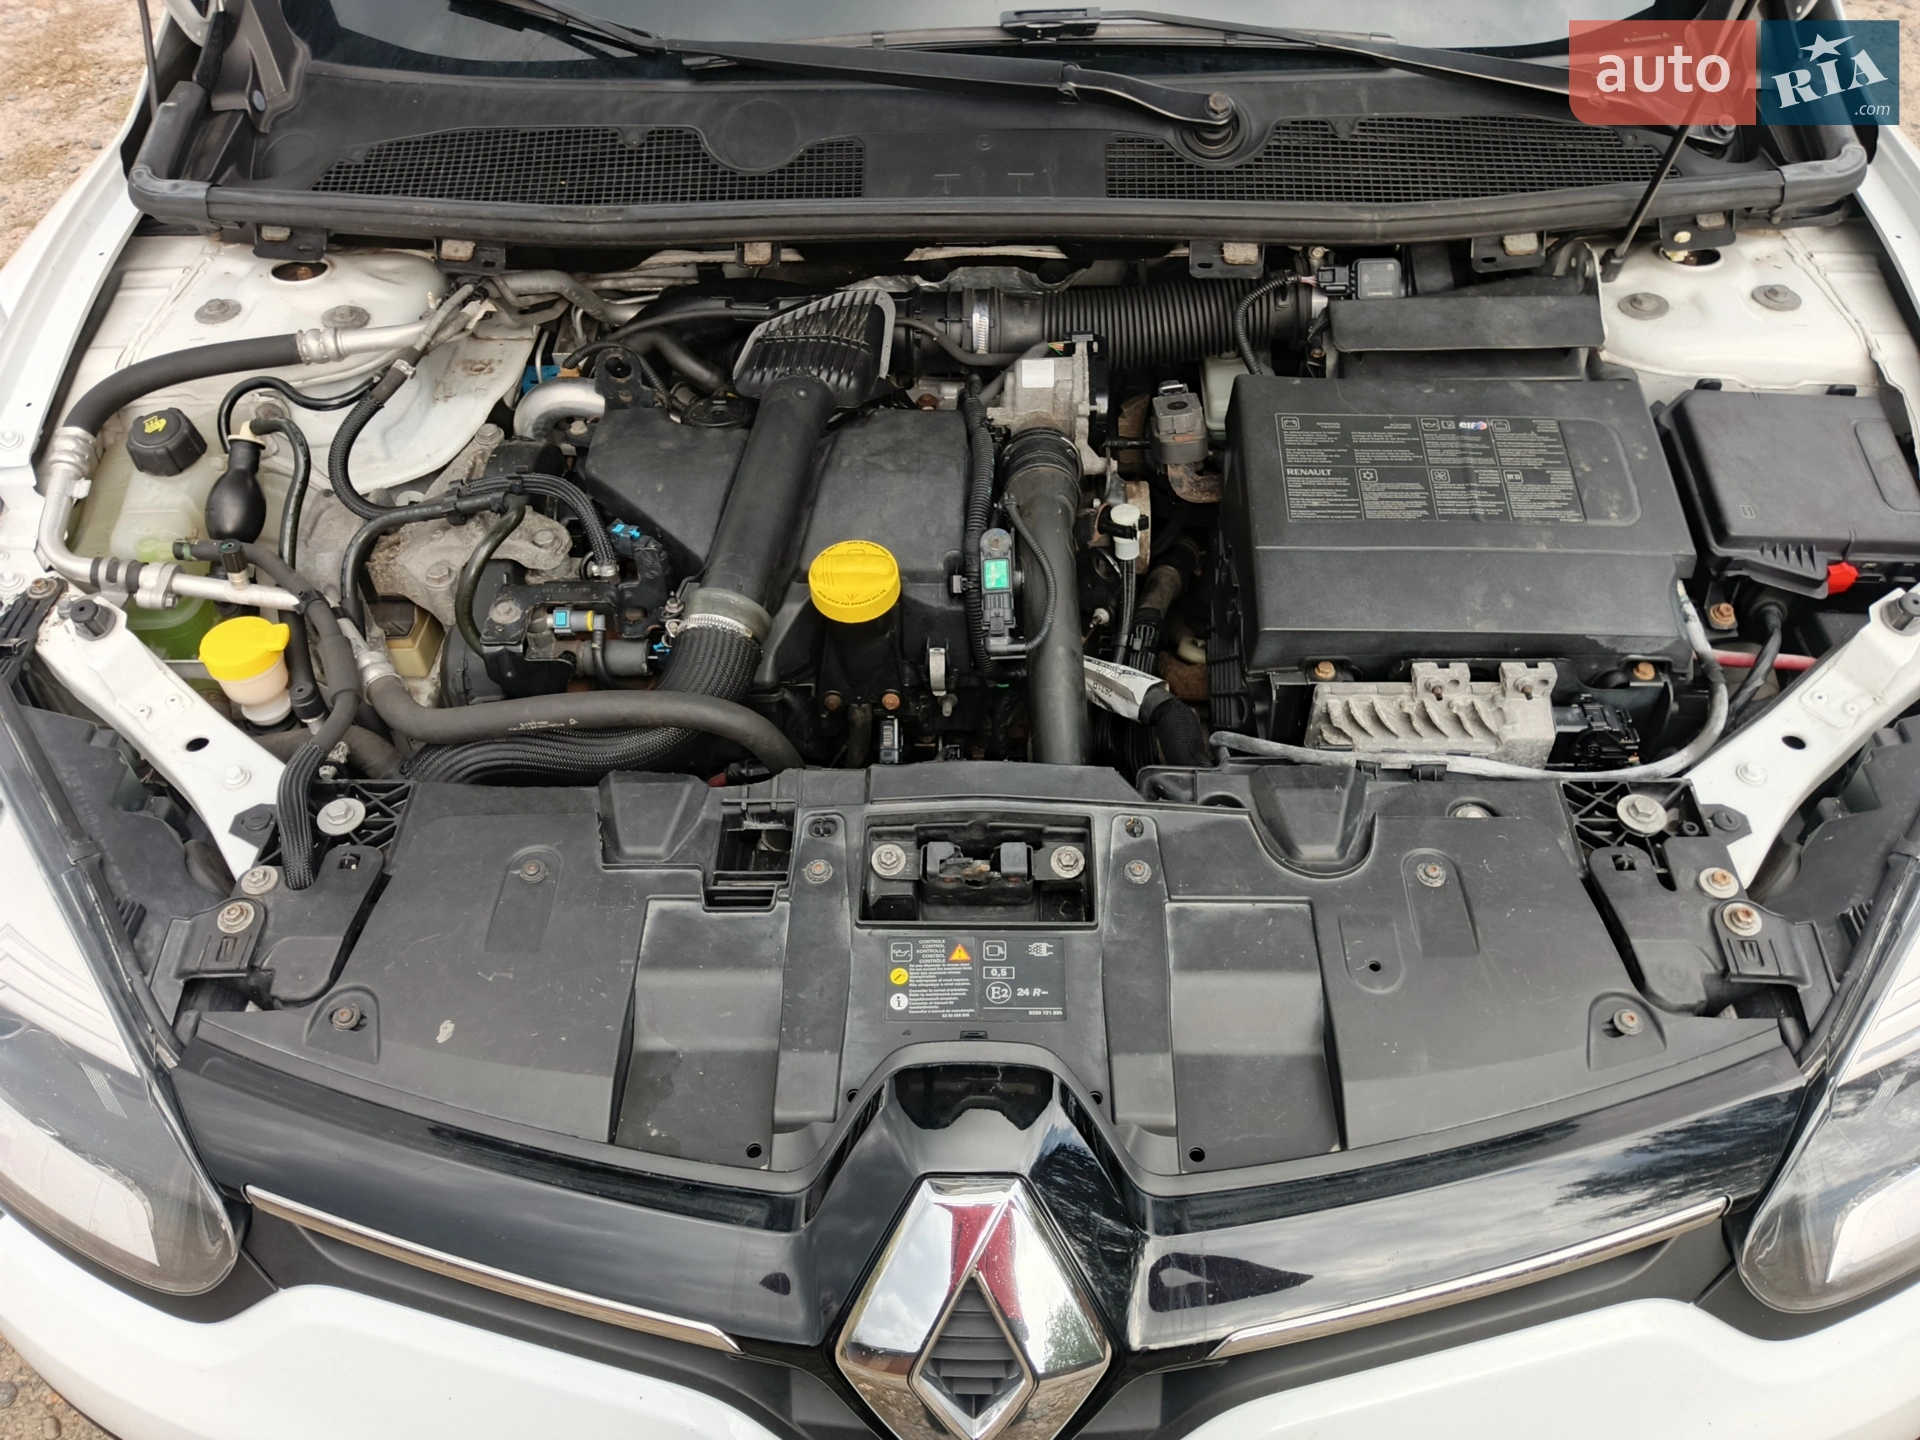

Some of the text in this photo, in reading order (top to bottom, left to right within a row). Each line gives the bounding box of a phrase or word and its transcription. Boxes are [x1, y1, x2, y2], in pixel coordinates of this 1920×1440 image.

[1286, 468, 1332, 476] RENAULT
[991, 968, 1007, 977] 0,5
[991, 986, 1009, 999] E2
[1017, 988, 1029, 996] 24
